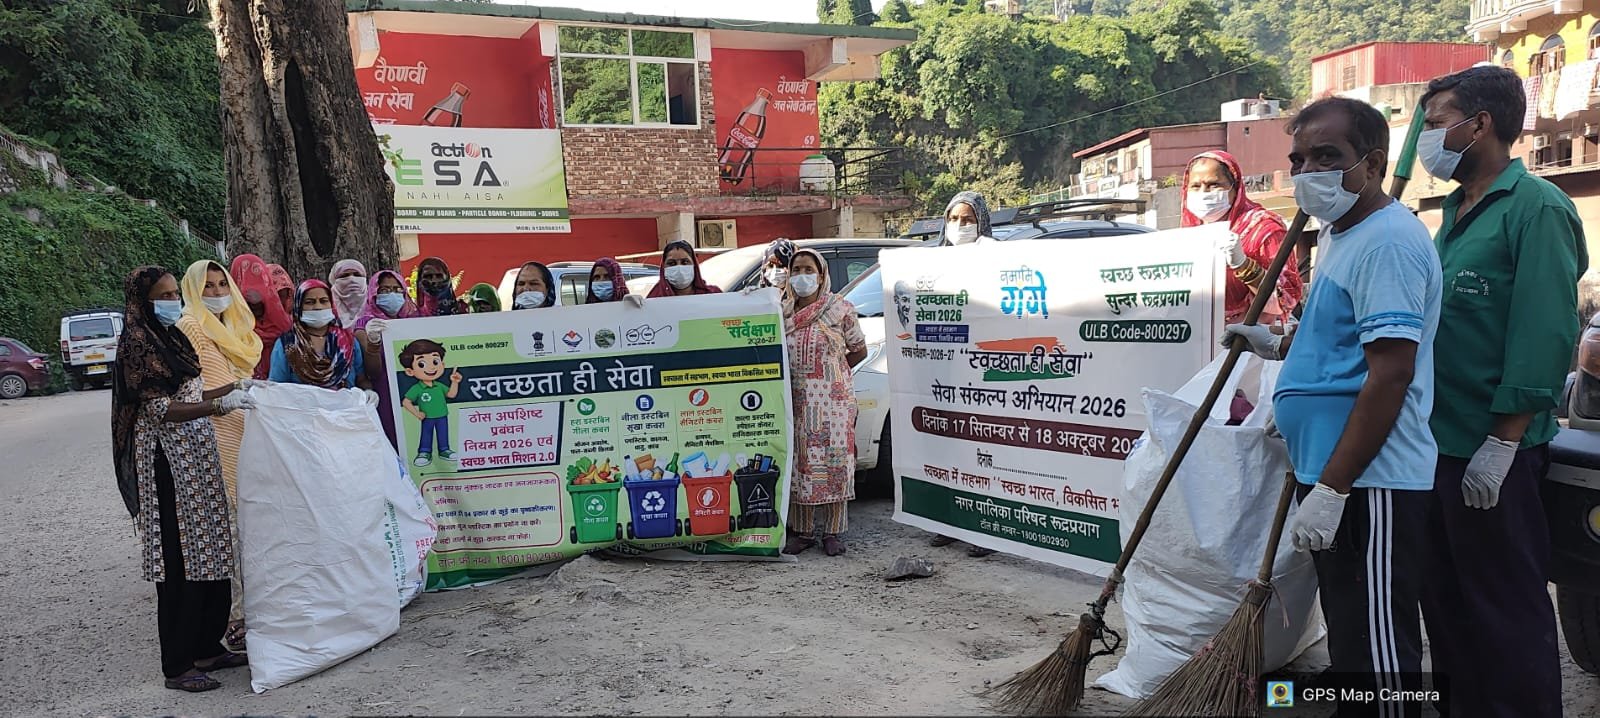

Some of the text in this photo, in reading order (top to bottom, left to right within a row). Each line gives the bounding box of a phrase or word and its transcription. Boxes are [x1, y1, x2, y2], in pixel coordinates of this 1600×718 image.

[386, 86, 415, 112] सेवा
[407, 192, 504, 201] NAHI AISA
[1000, 265, 1033, 285] नमामि
[1100, 267, 1133, 283] स्वच्छ
[915, 289, 969, 306] स्वच्छता ही
[1105, 293, 1138, 315] सुन्दर
[915, 307, 962, 321] सेवा 2026
[727, 320, 776, 338] सर्वेक्षण
[1085, 324, 1188, 339] ULB Code-800297
[485, 341, 508, 349] 800297
[1030, 346, 1045, 372] ही
[468, 360, 653, 399] स्वच्छता ही सेवा
[931, 379, 1126, 418] सेवा संकल्प अभियान 2026
[468, 408, 543, 423] ठोस अपशिष्ट
[491, 424, 524, 436] प्रबंधन
[922, 410, 1135, 456] दिनांक 17 सितम्बर से 18 अक्टूबर 20
[464, 435, 553, 452] नियम 2026 एवं
[461, 452, 554, 467] स्वच्छ भारत मिशन 2.0
[924, 464, 949, 482] स्वच्छता
[961, 473, 990, 490] सहभाग
[1063, 485, 1108, 512] विकसित
[954, 495, 973, 511] नगर
[975, 499, 1011, 520] पालिका
[1013, 505, 1047, 528] परिषद
